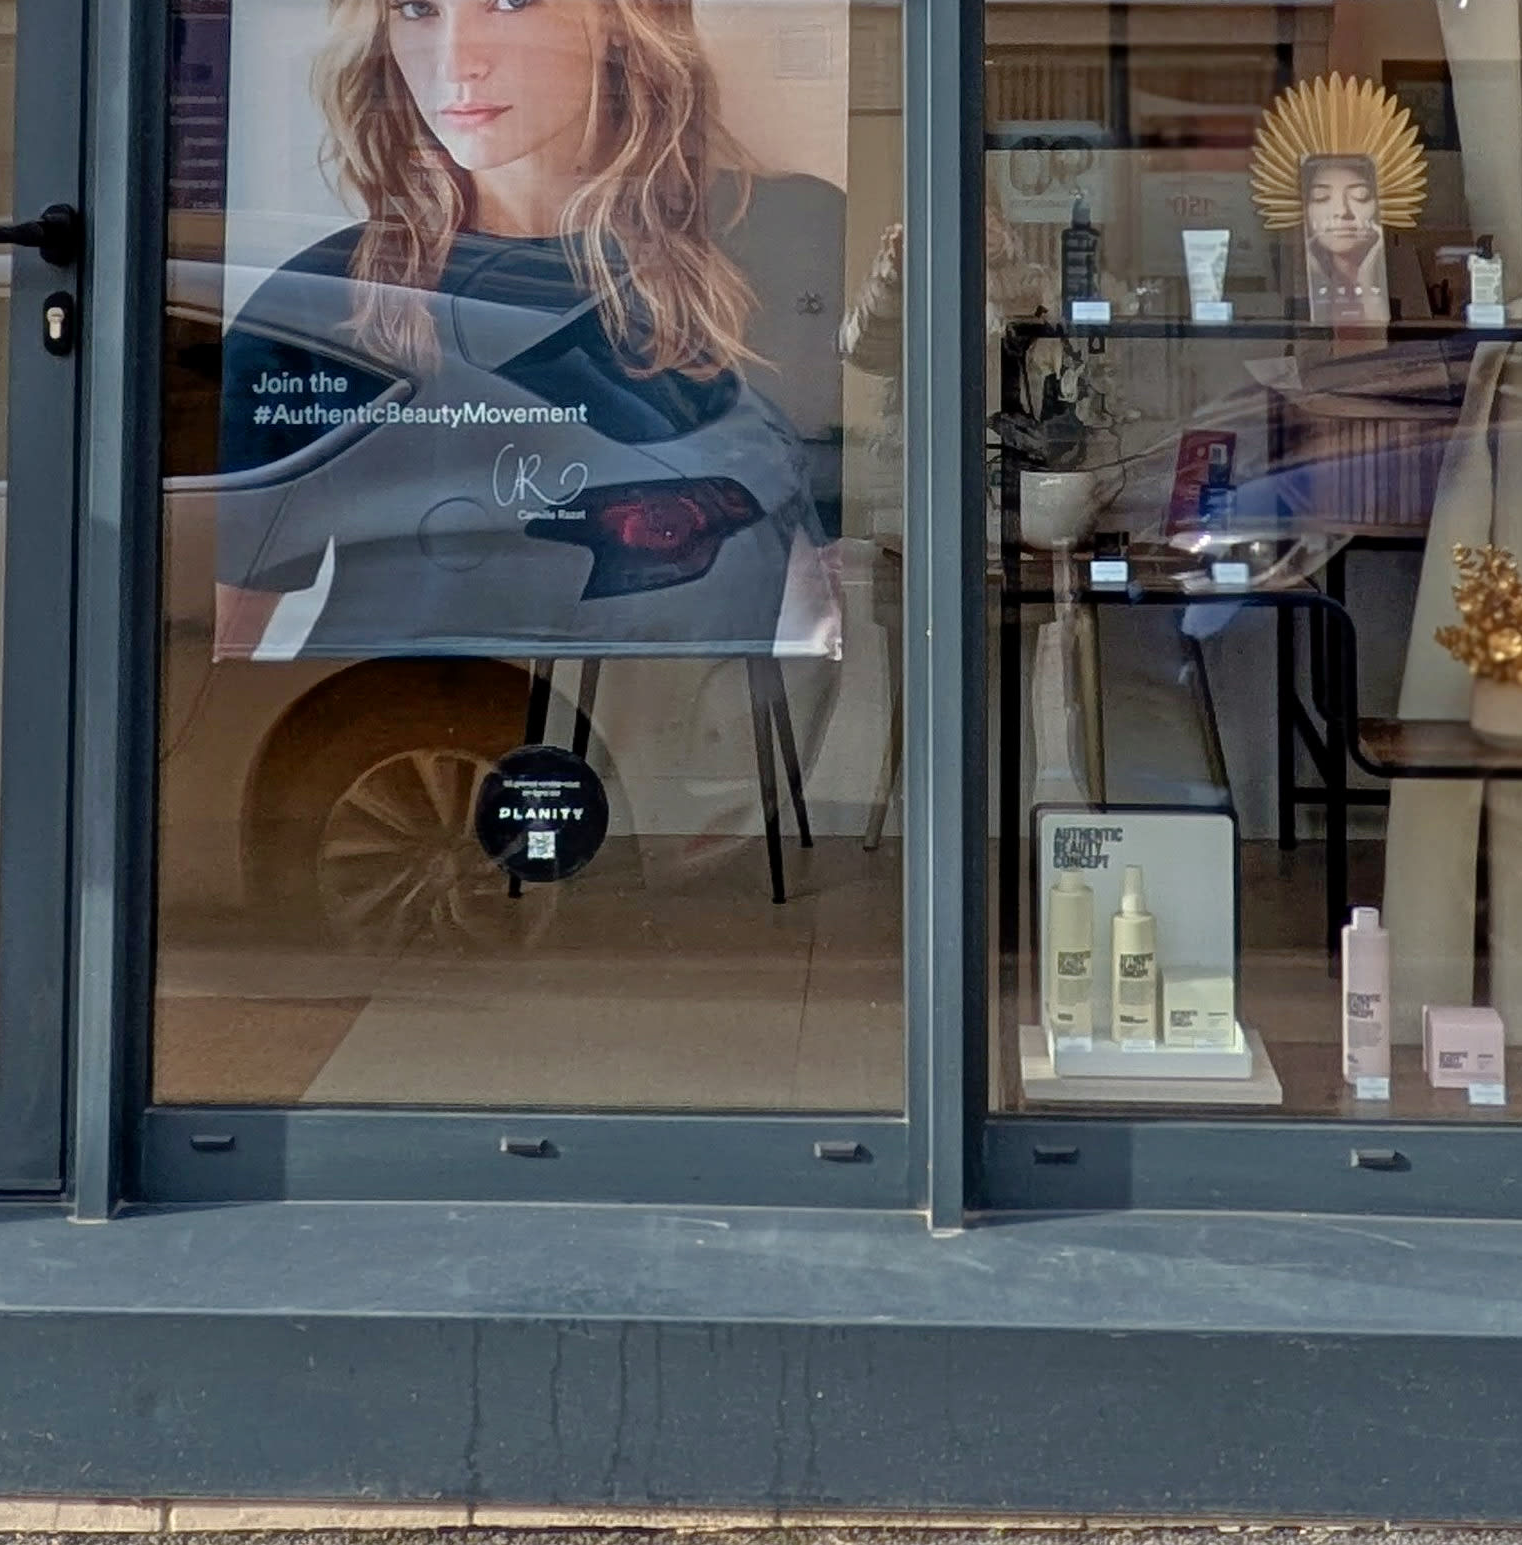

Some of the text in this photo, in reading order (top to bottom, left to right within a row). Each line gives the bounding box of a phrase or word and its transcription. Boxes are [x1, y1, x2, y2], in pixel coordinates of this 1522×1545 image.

[252, 372, 348, 394] Join the
[253, 401, 588, 429] #AuthenticBeautyMovement
[498, 806, 584, 821] PLANITY
